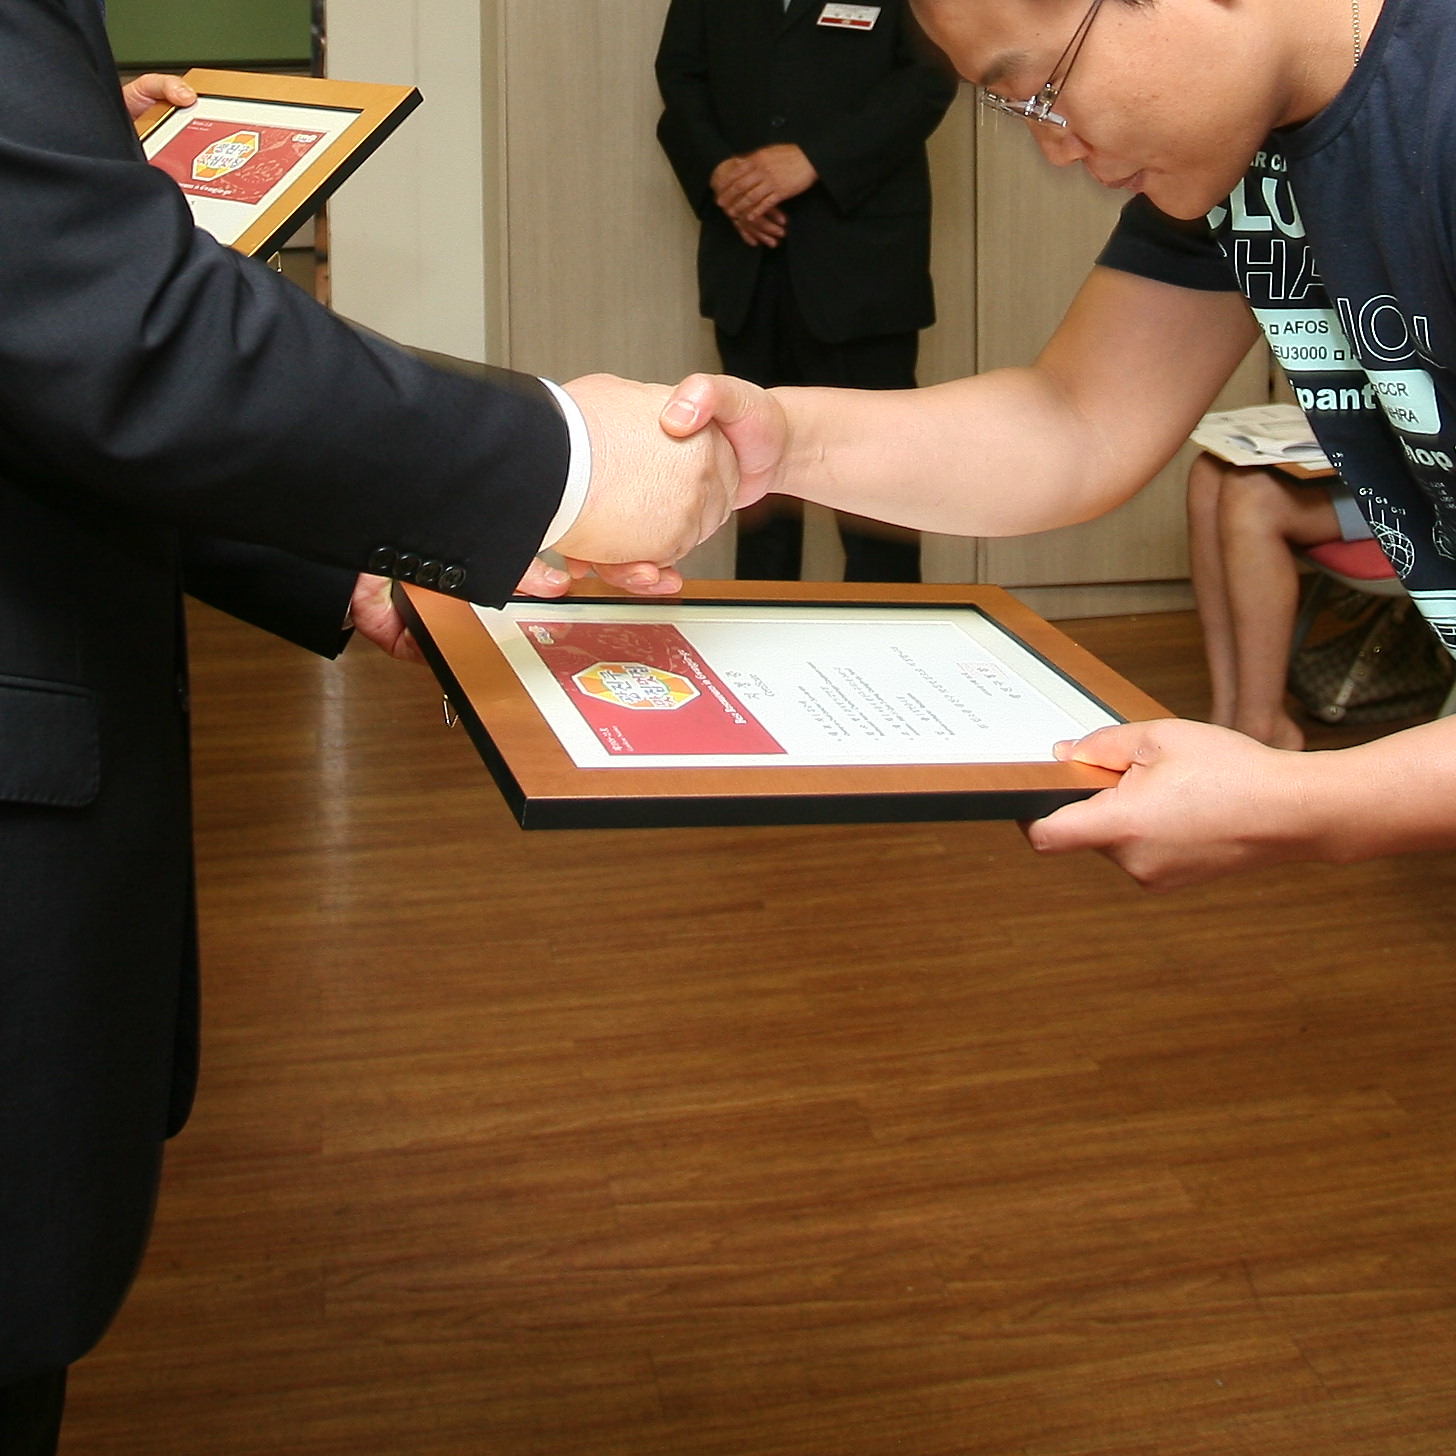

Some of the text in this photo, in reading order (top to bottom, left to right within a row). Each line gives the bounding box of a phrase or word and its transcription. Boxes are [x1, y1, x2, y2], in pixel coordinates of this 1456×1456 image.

[1206, 176, 1306, 239] LU
[1217, 239, 1325, 301] HA
[1283, 320, 1329, 335] AFOS
[600, 670, 641, 703] 광진구
